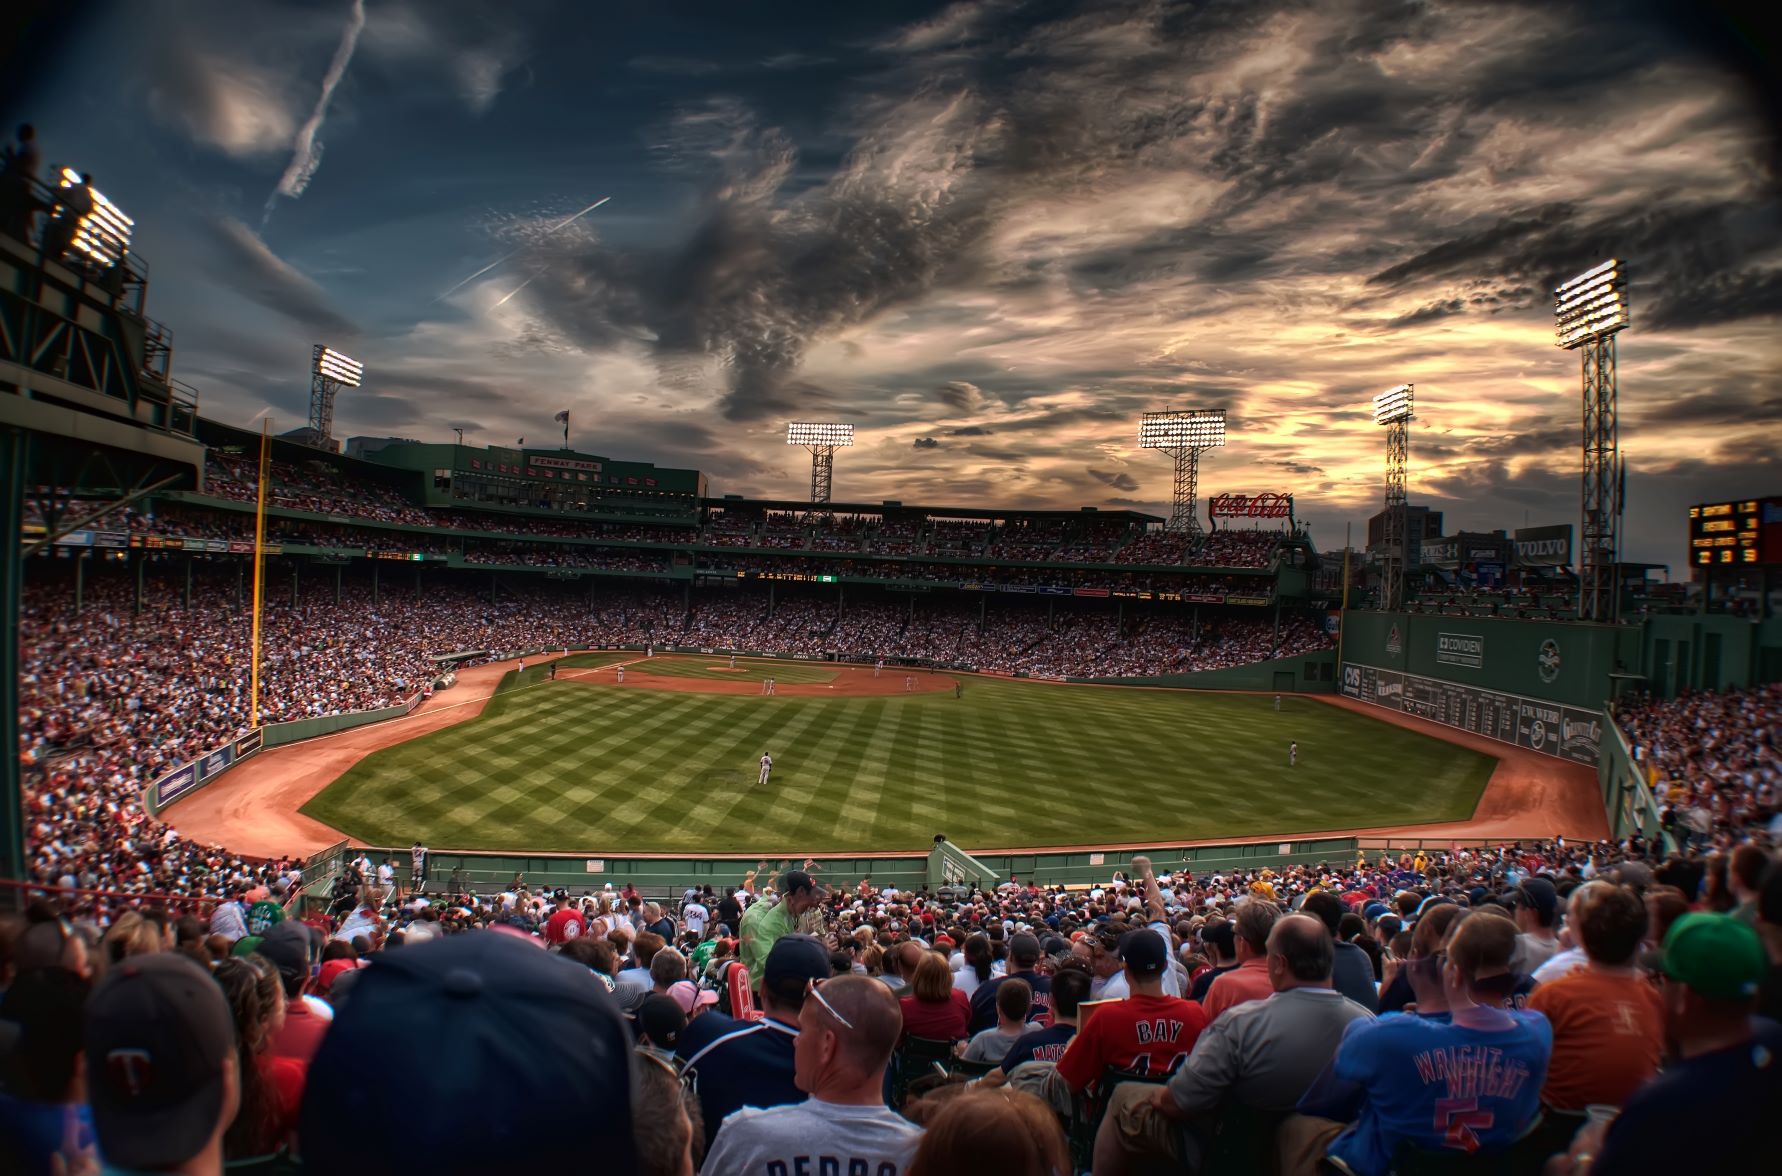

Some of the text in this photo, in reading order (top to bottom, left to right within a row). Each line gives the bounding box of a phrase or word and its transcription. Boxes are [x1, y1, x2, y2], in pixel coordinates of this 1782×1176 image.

[534, 457, 599, 470] FENWAY PARK
[1211, 491, 1294, 519] Coca-Cola
[1517, 538, 1567, 556] VOLVO
[1448, 638, 1481, 653] COVIDIEN
[1344, 666, 1361, 687] CVS
[1135, 1018, 1185, 1045] BAY
